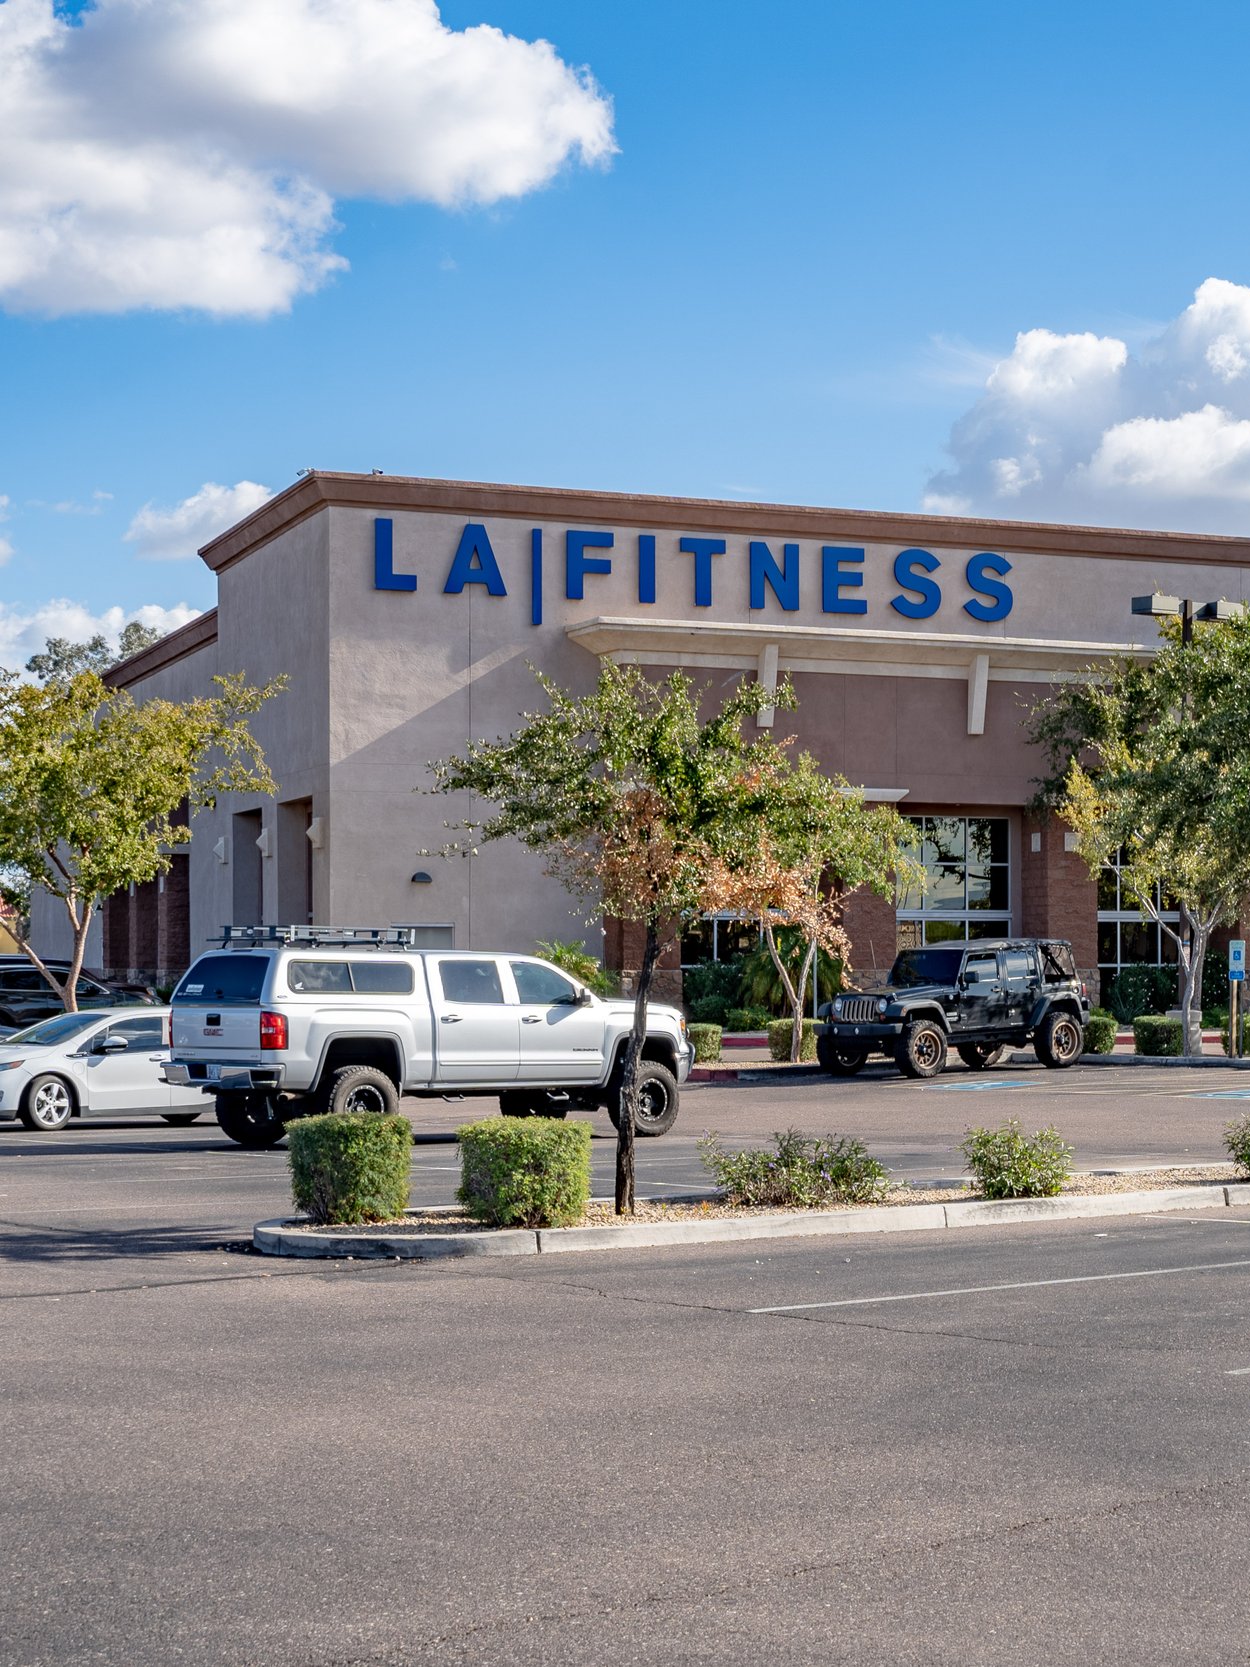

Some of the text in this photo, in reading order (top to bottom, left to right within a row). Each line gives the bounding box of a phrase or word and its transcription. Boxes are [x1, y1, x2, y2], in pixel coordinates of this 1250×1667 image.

[374, 517, 1014, 623] LA FITNESS
[203, 1028, 224, 1036] GMC
